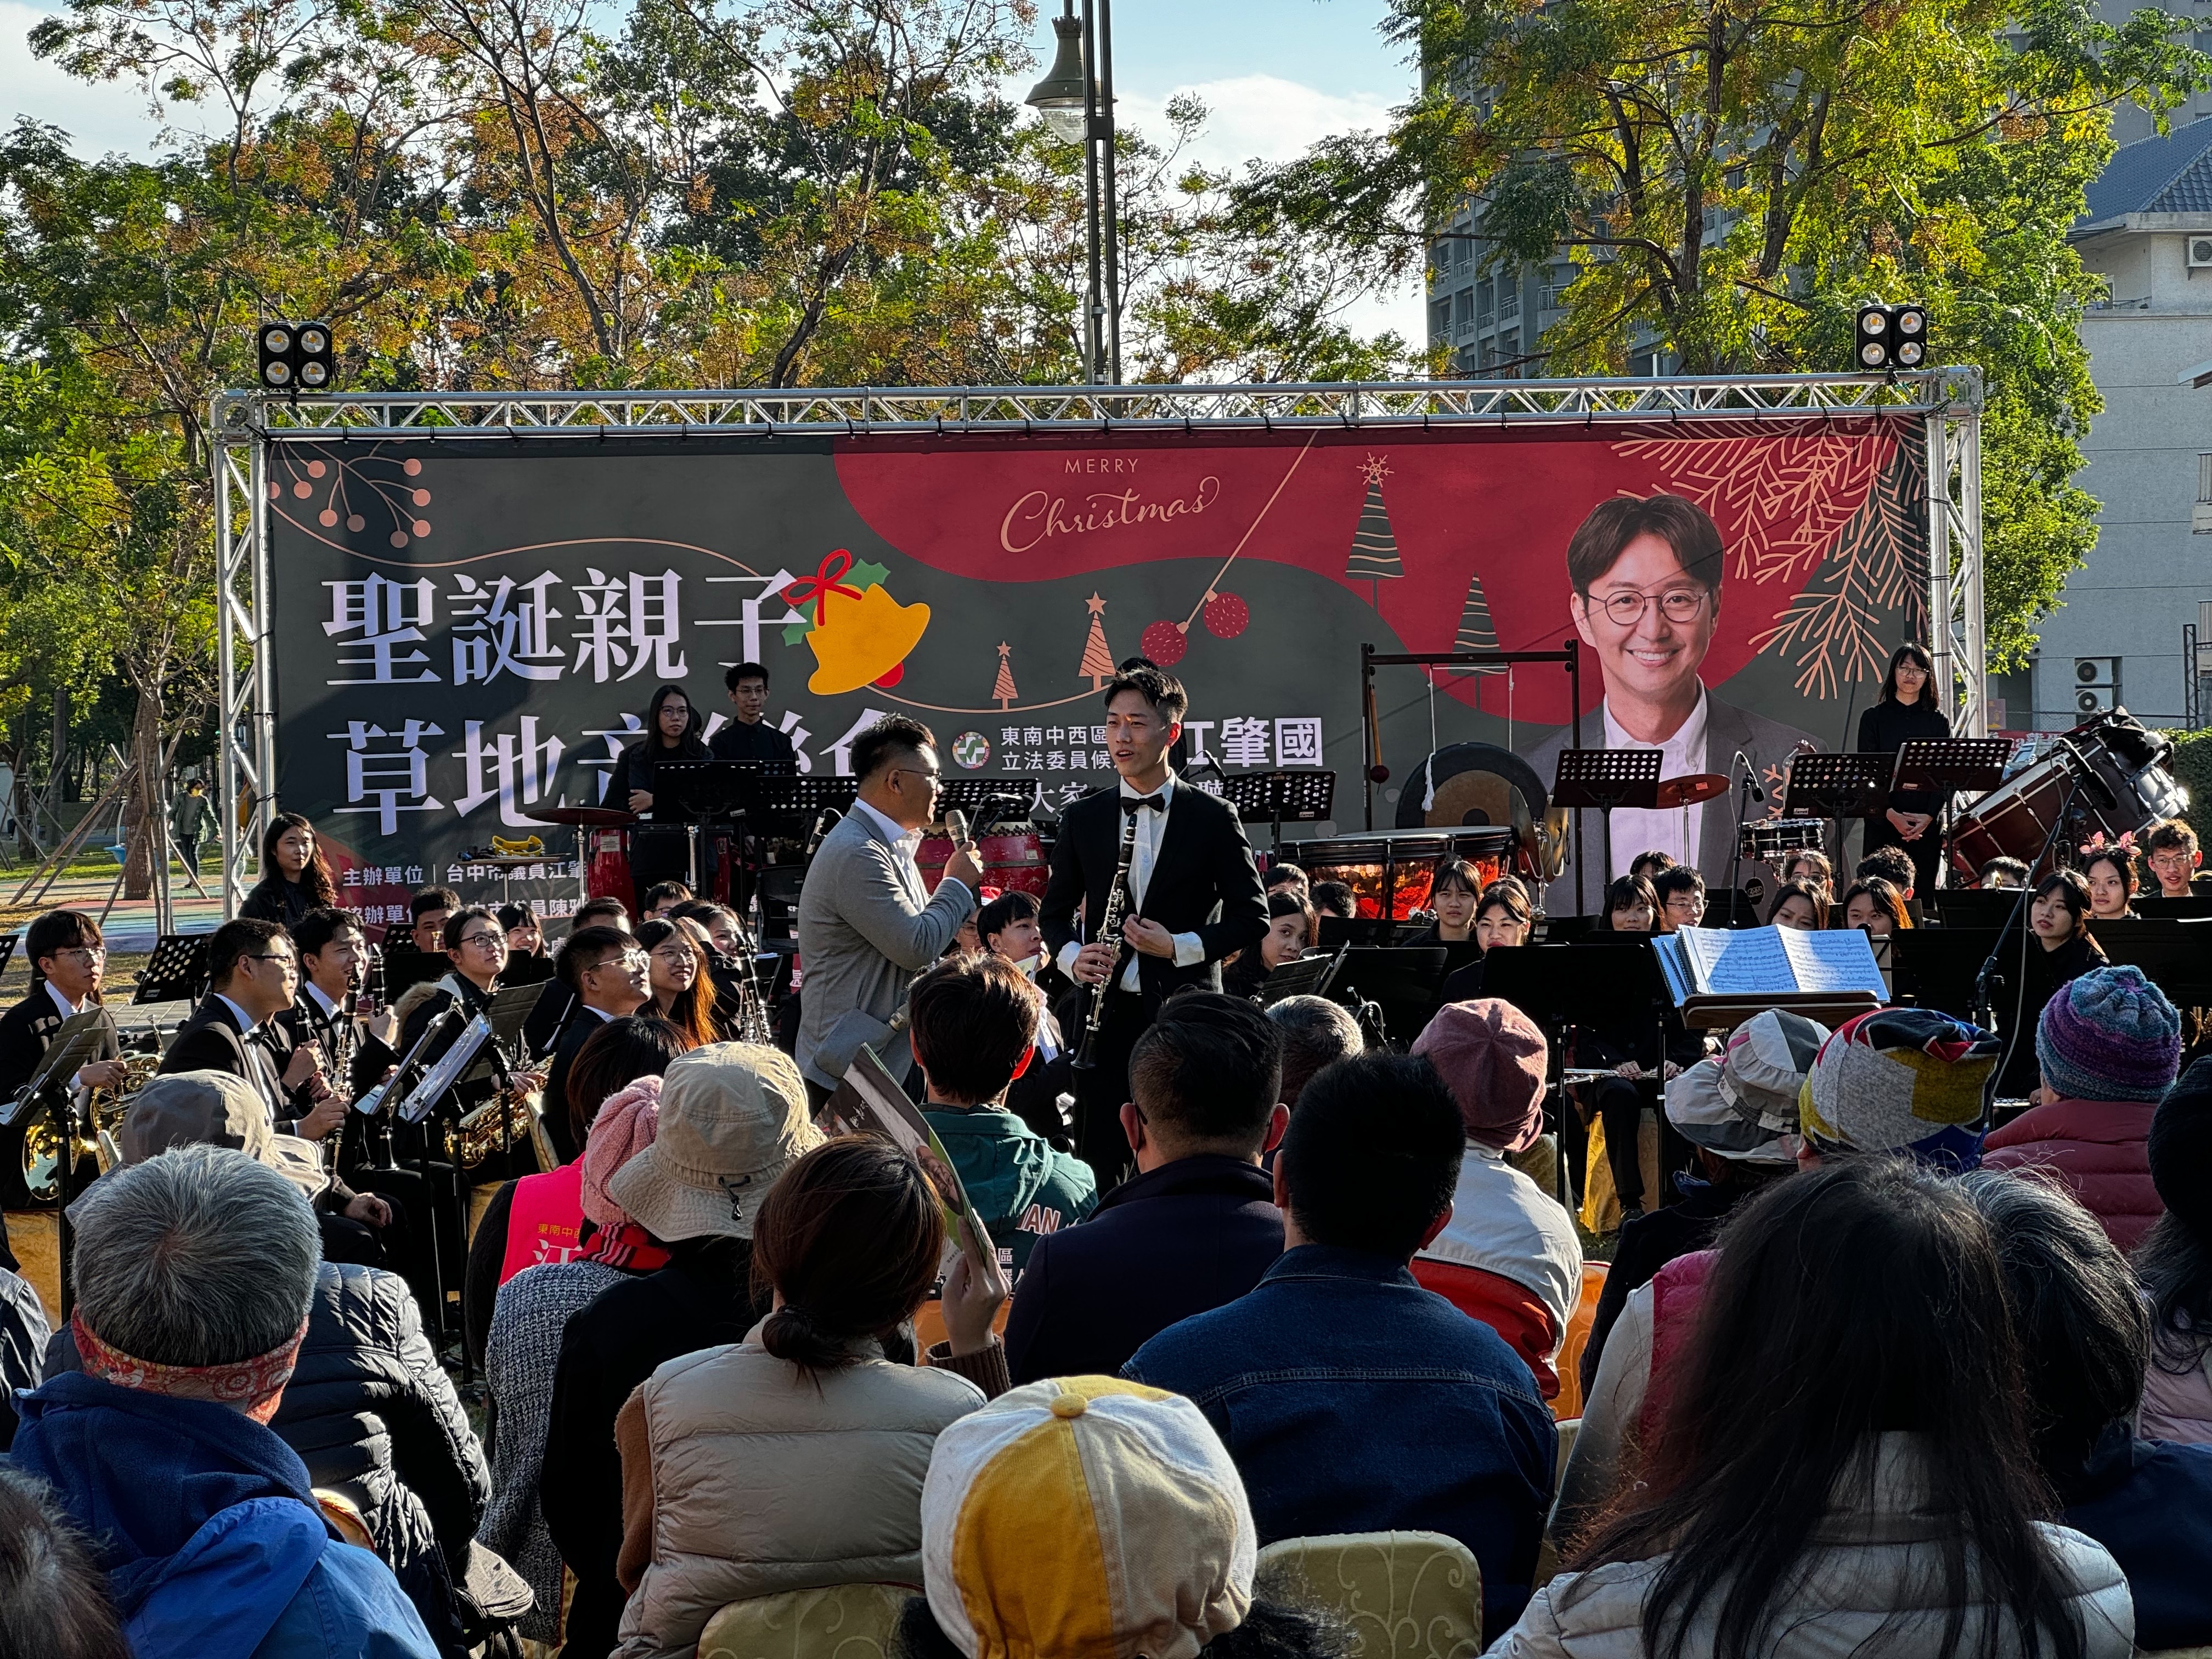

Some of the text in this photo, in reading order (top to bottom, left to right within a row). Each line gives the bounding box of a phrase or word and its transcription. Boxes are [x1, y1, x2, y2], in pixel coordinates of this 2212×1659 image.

[1065, 459, 1139, 473] MERRY
[1000, 476, 1220, 553] Christmas
[321, 567, 808, 686] 聖誕親子
[1000, 725, 1108, 747] 東南中西區
[1001, 751, 1118, 770] 立法委員候
[342, 865, 424, 887] 主辦單位
[537, 1223, 580, 1239] 東南中西
